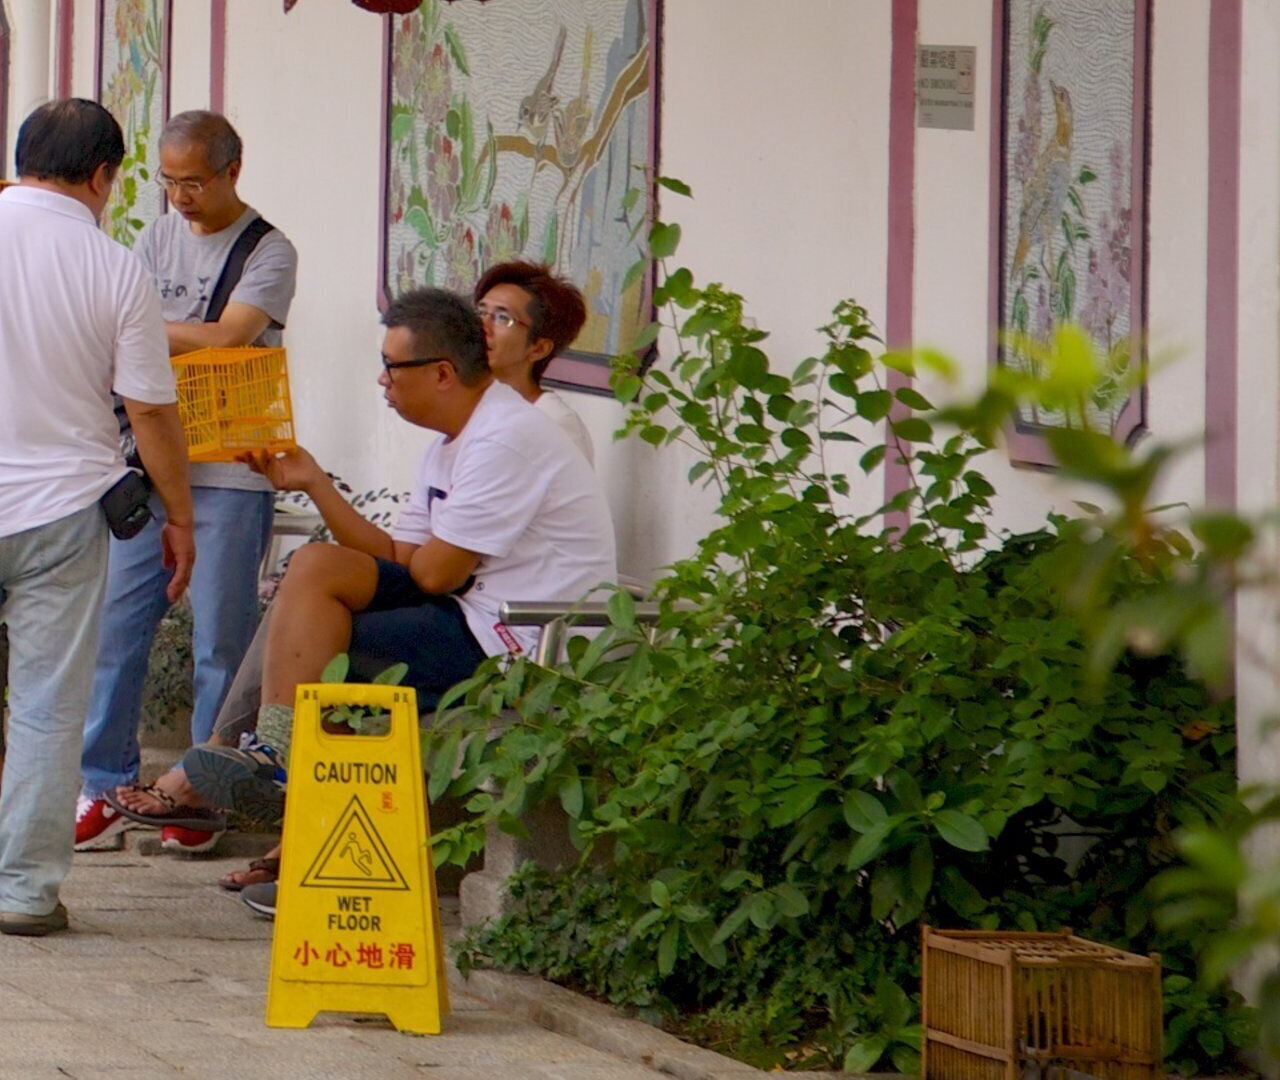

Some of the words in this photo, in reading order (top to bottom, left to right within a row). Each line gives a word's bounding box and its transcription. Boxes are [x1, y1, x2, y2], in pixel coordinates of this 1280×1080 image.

[314, 761, 397, 784] CAUTION
[337, 896, 372, 912] WET
[328, 914, 381, 931] FLOOR
[293, 940, 416, 970] 小心地滑
